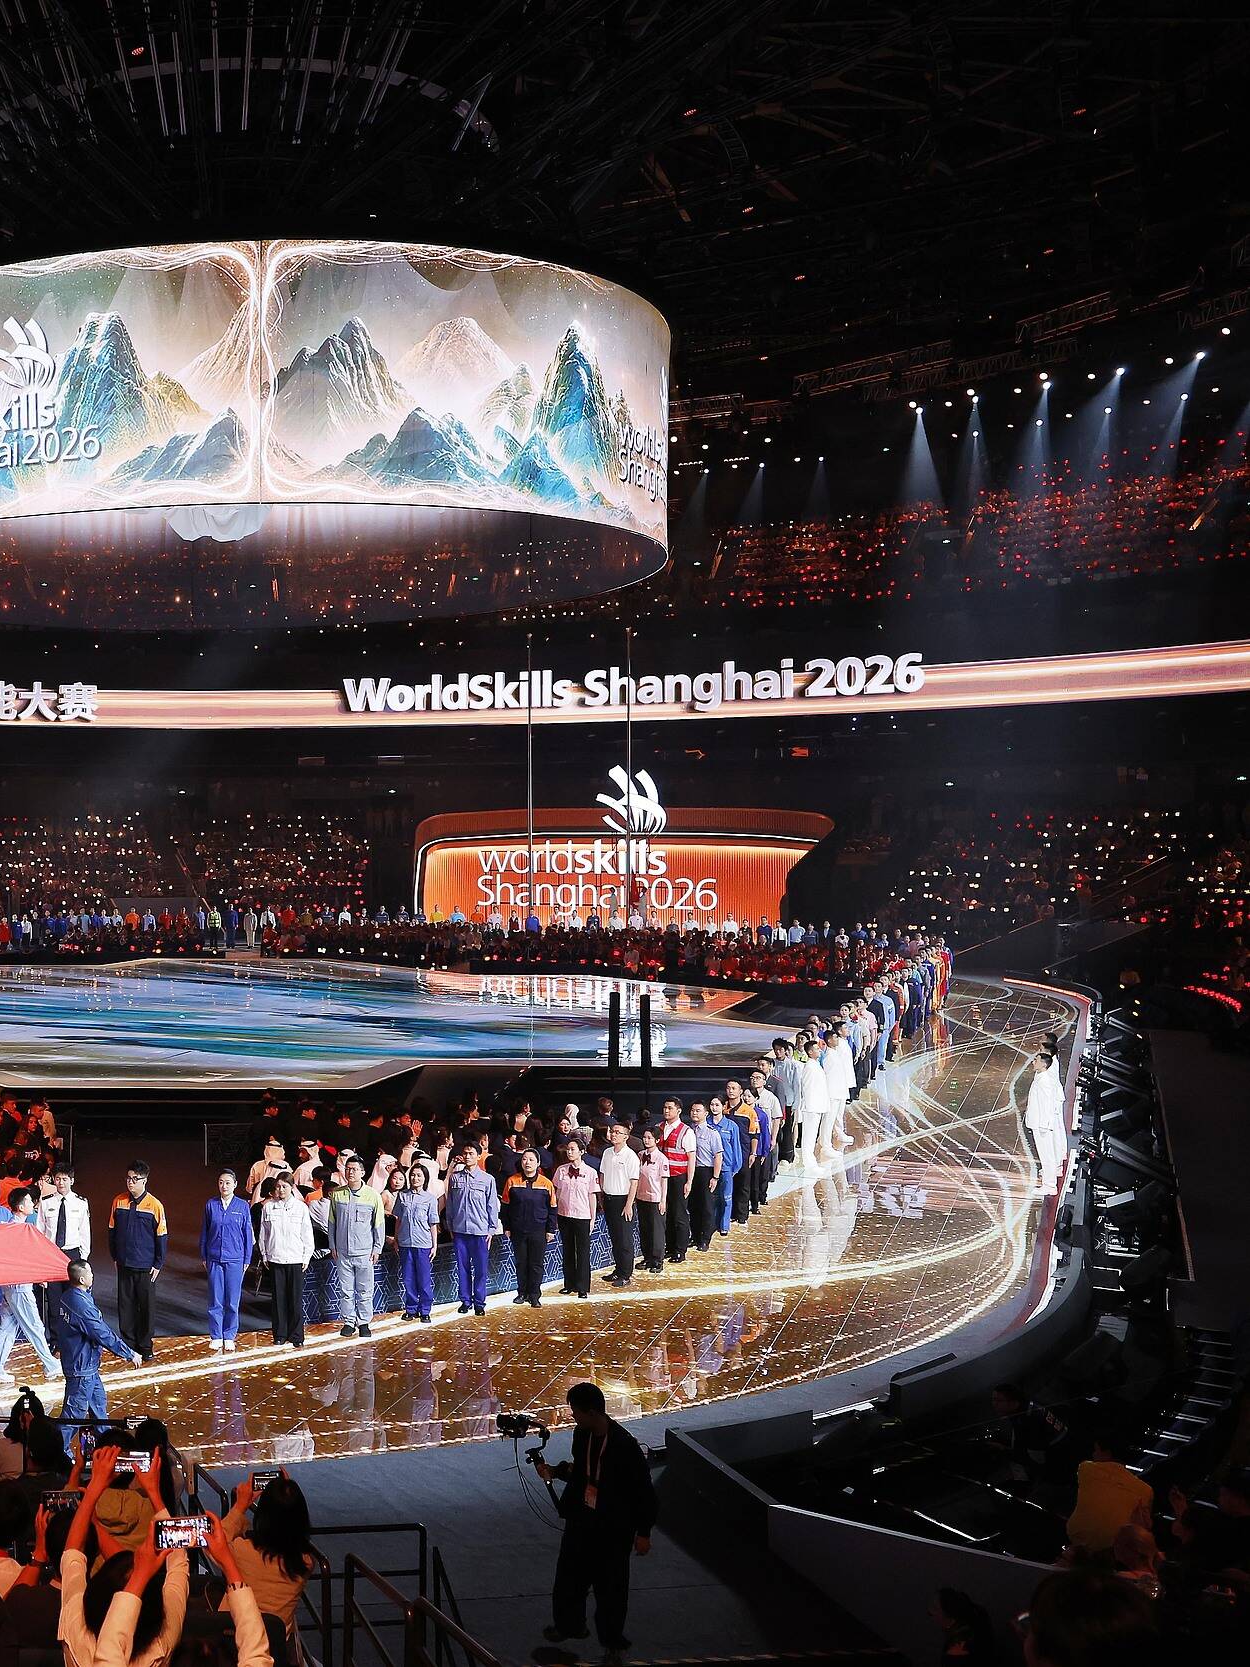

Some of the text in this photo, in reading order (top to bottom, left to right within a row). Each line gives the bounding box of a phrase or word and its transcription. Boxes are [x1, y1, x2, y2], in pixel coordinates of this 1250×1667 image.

[23, 424, 103, 466] 2026
[619, 424, 665, 463] worlds
[343, 652, 925, 712] WorldSkills Shanghai 2026
[478, 838, 667, 876] worldskills
[477, 873, 627, 916] Shanghai
